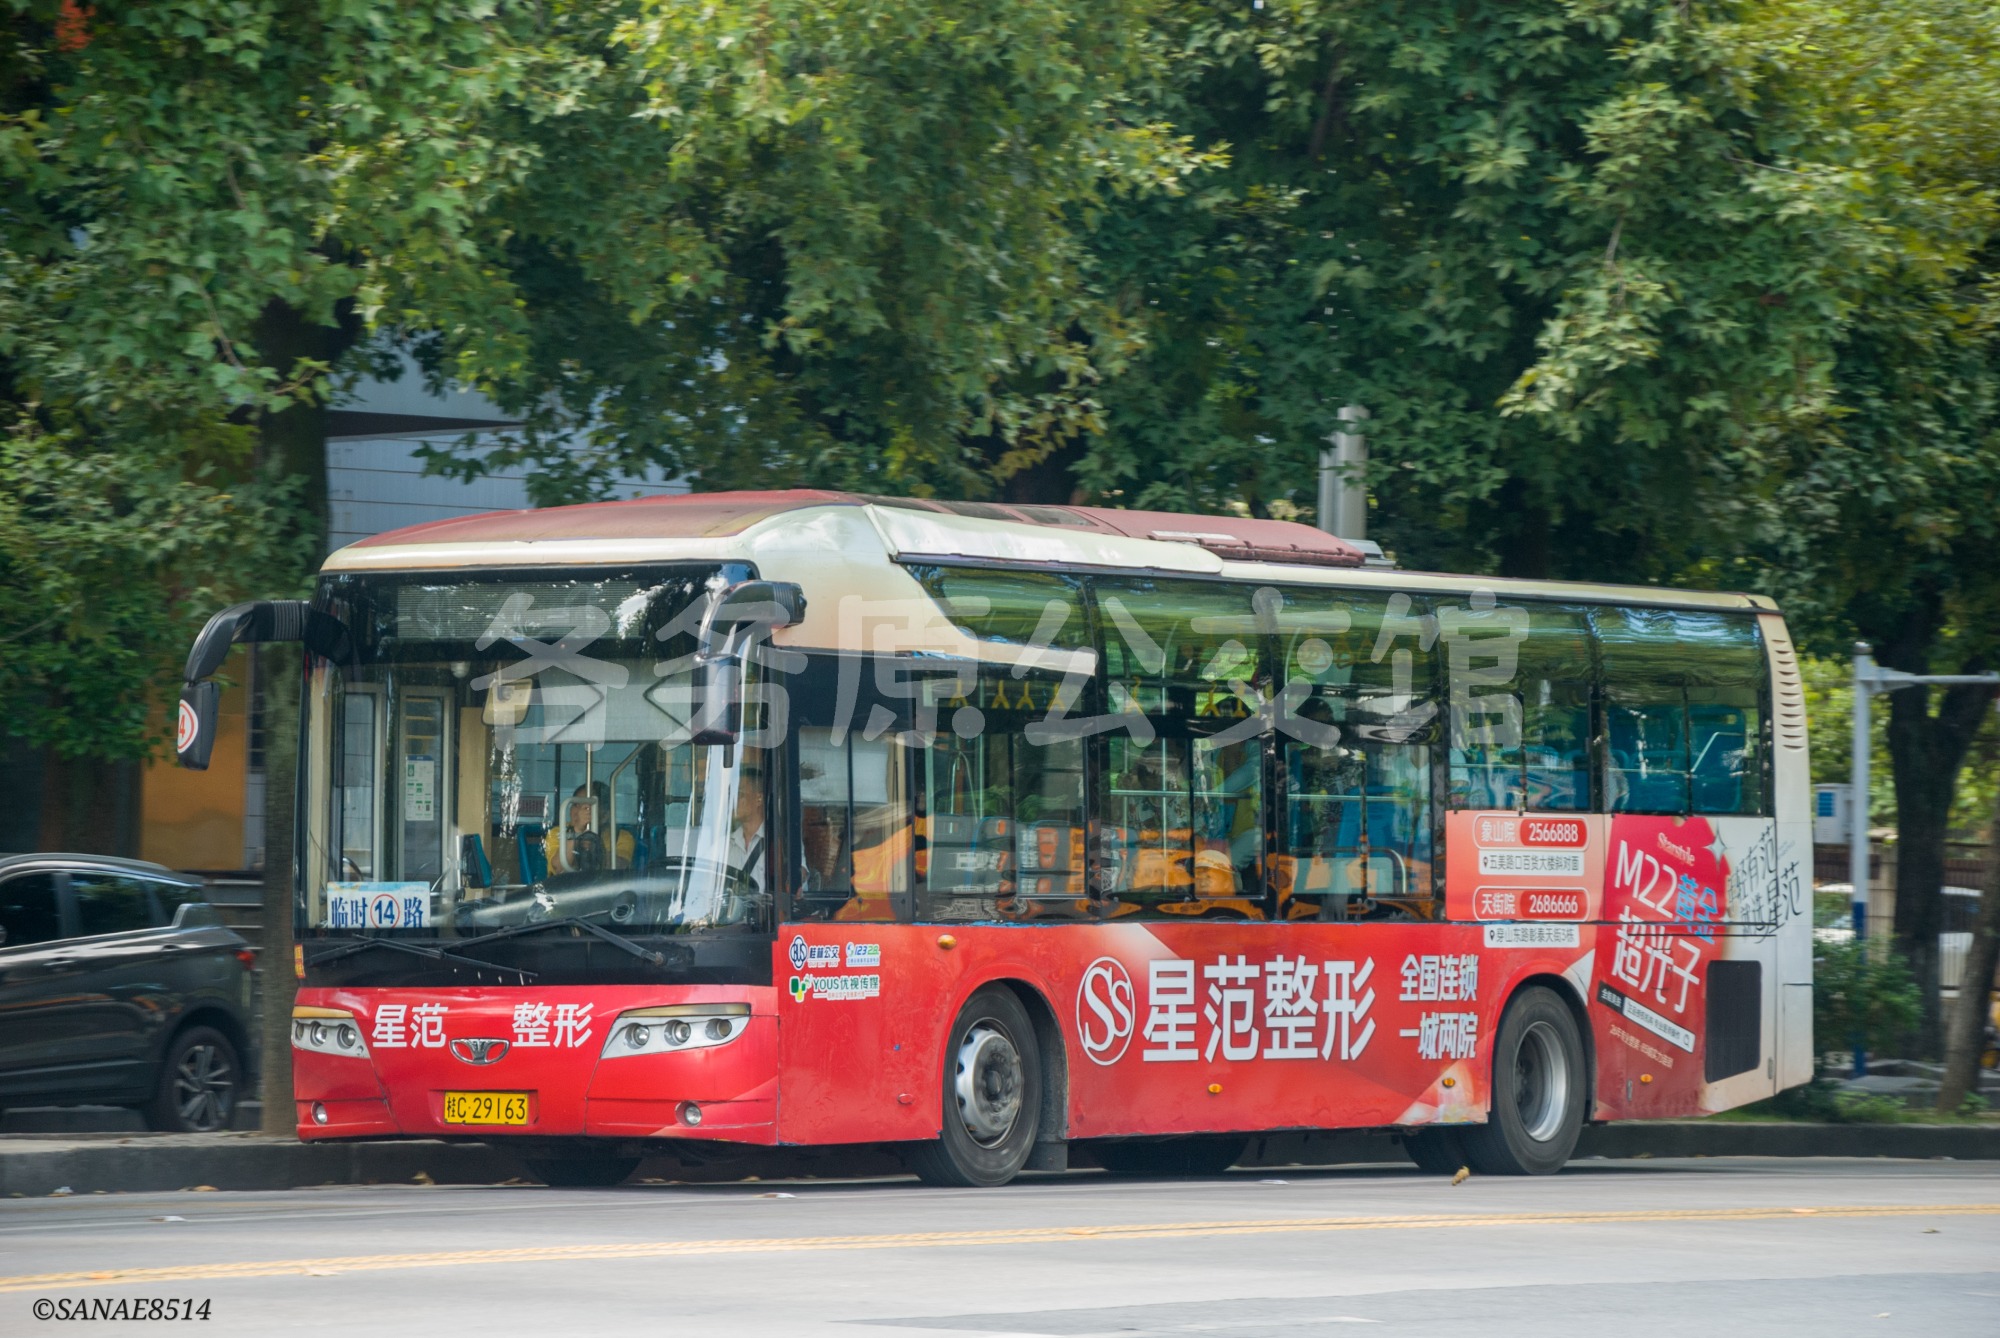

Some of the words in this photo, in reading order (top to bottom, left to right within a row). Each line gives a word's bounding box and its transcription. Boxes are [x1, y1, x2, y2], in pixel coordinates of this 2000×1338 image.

[1481, 821, 1516, 842] 象山院
[1529, 823, 1579, 843] 2566888
[1481, 893, 1516, 914] 天街院
[1529, 894, 1578, 913] 2686666
[1614, 840, 1677, 919] M22
[1399, 953, 1478, 1002] 全国连锁
[1611, 905, 1700, 1013] 超光子
[372, 1002, 449, 1049] 星范
[512, 1002, 594, 1048] 整形
[1142, 954, 1376, 1063] 星范整形
[1399, 1011, 1478, 1060] 一城两院
